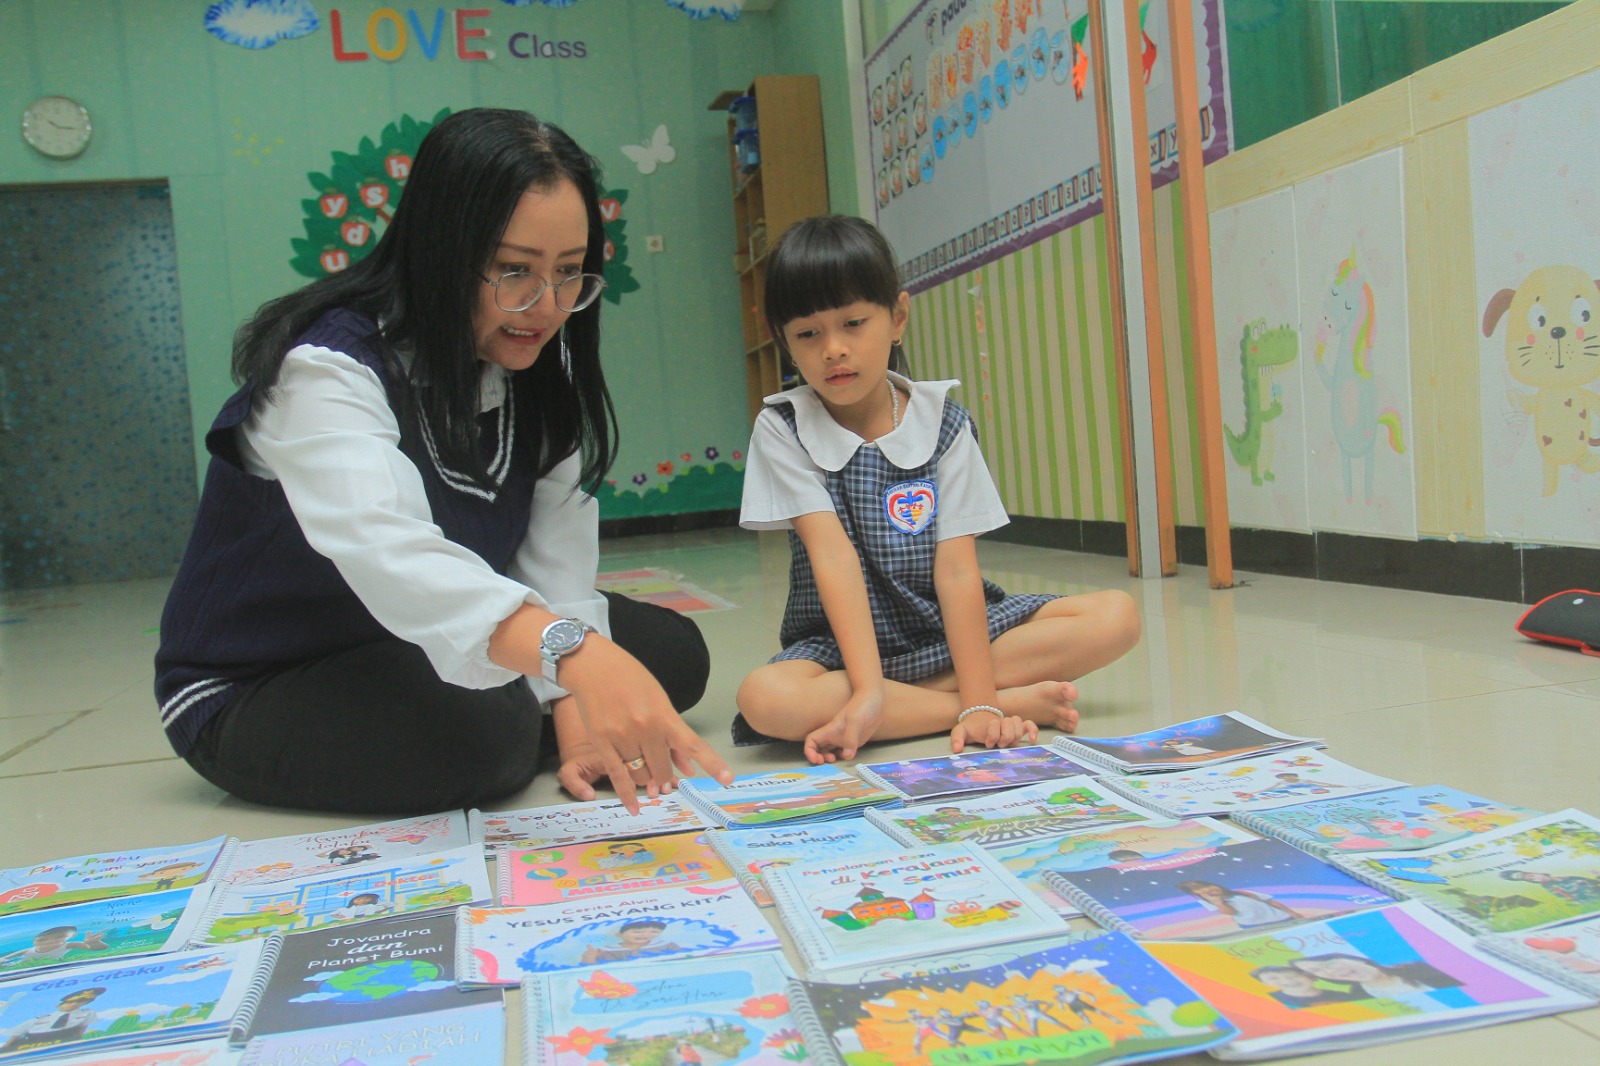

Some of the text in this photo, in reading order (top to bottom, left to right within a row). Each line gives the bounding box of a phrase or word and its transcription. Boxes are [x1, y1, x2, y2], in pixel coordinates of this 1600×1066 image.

[330, 8, 587, 61] LOVE Class
[389, 158, 409, 178] h
[366, 186, 384, 206] s
[325, 197, 345, 217] y
[346, 224, 364, 245] d
[325, 253, 346, 272] u
[747, 832, 857, 849] Suka Hujan
[770, 829, 809, 839] Levi
[29, 864, 64, 877] Pak
[557, 861, 706, 888] DOKTER
[830, 855, 974, 886] di Kerajaan
[902, 865, 982, 886] Semut
[566, 873, 708, 897] MICHELLE
[506, 894, 733, 929] YESUS SAYANG KITA
[562, 897, 659, 915] Cerita Alvin
[327, 928, 432, 948] Jovandra
[347, 940, 407, 955] dan
[308, 944, 444, 970] Planet Bumi
[32, 965, 165, 992] Cita-citaku
[382, 1022, 466, 1043] YANG
